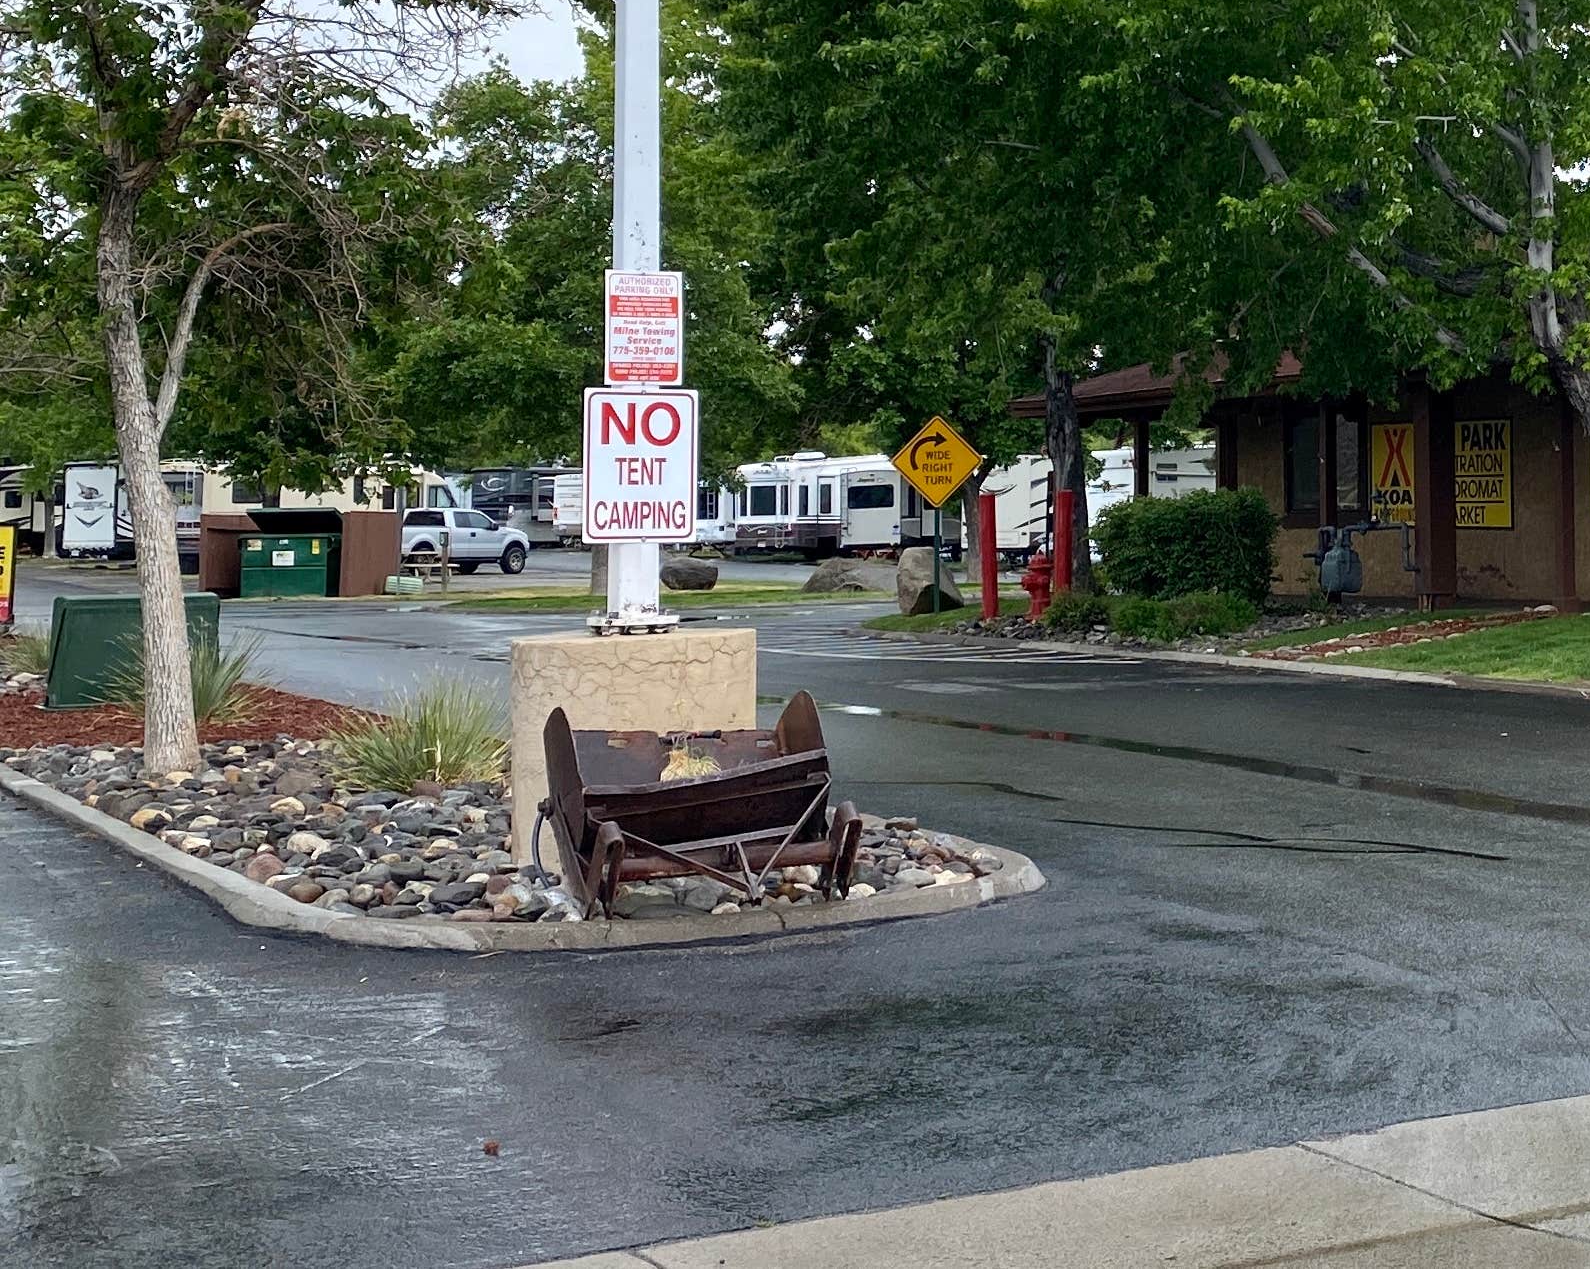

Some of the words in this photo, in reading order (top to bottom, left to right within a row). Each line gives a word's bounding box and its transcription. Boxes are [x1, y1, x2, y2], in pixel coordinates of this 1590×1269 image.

[618, 277, 671, 286] AUTHORIZED
[614, 285, 651, 294] PARKING
[653, 286, 674, 295] ONLY
[613, 326, 640, 335] Milne
[642, 327, 676, 337] Towing
[626, 336, 662, 344] Service
[601, 401, 681, 447] NO
[1461, 422, 1506, 452] PARK
[925, 450, 951, 460] WIDE
[614, 457, 667, 485] TENT
[922, 463, 953, 473] RIGHT
[924, 475, 953, 485] TURN
[594, 500, 686, 530] CAMPING
